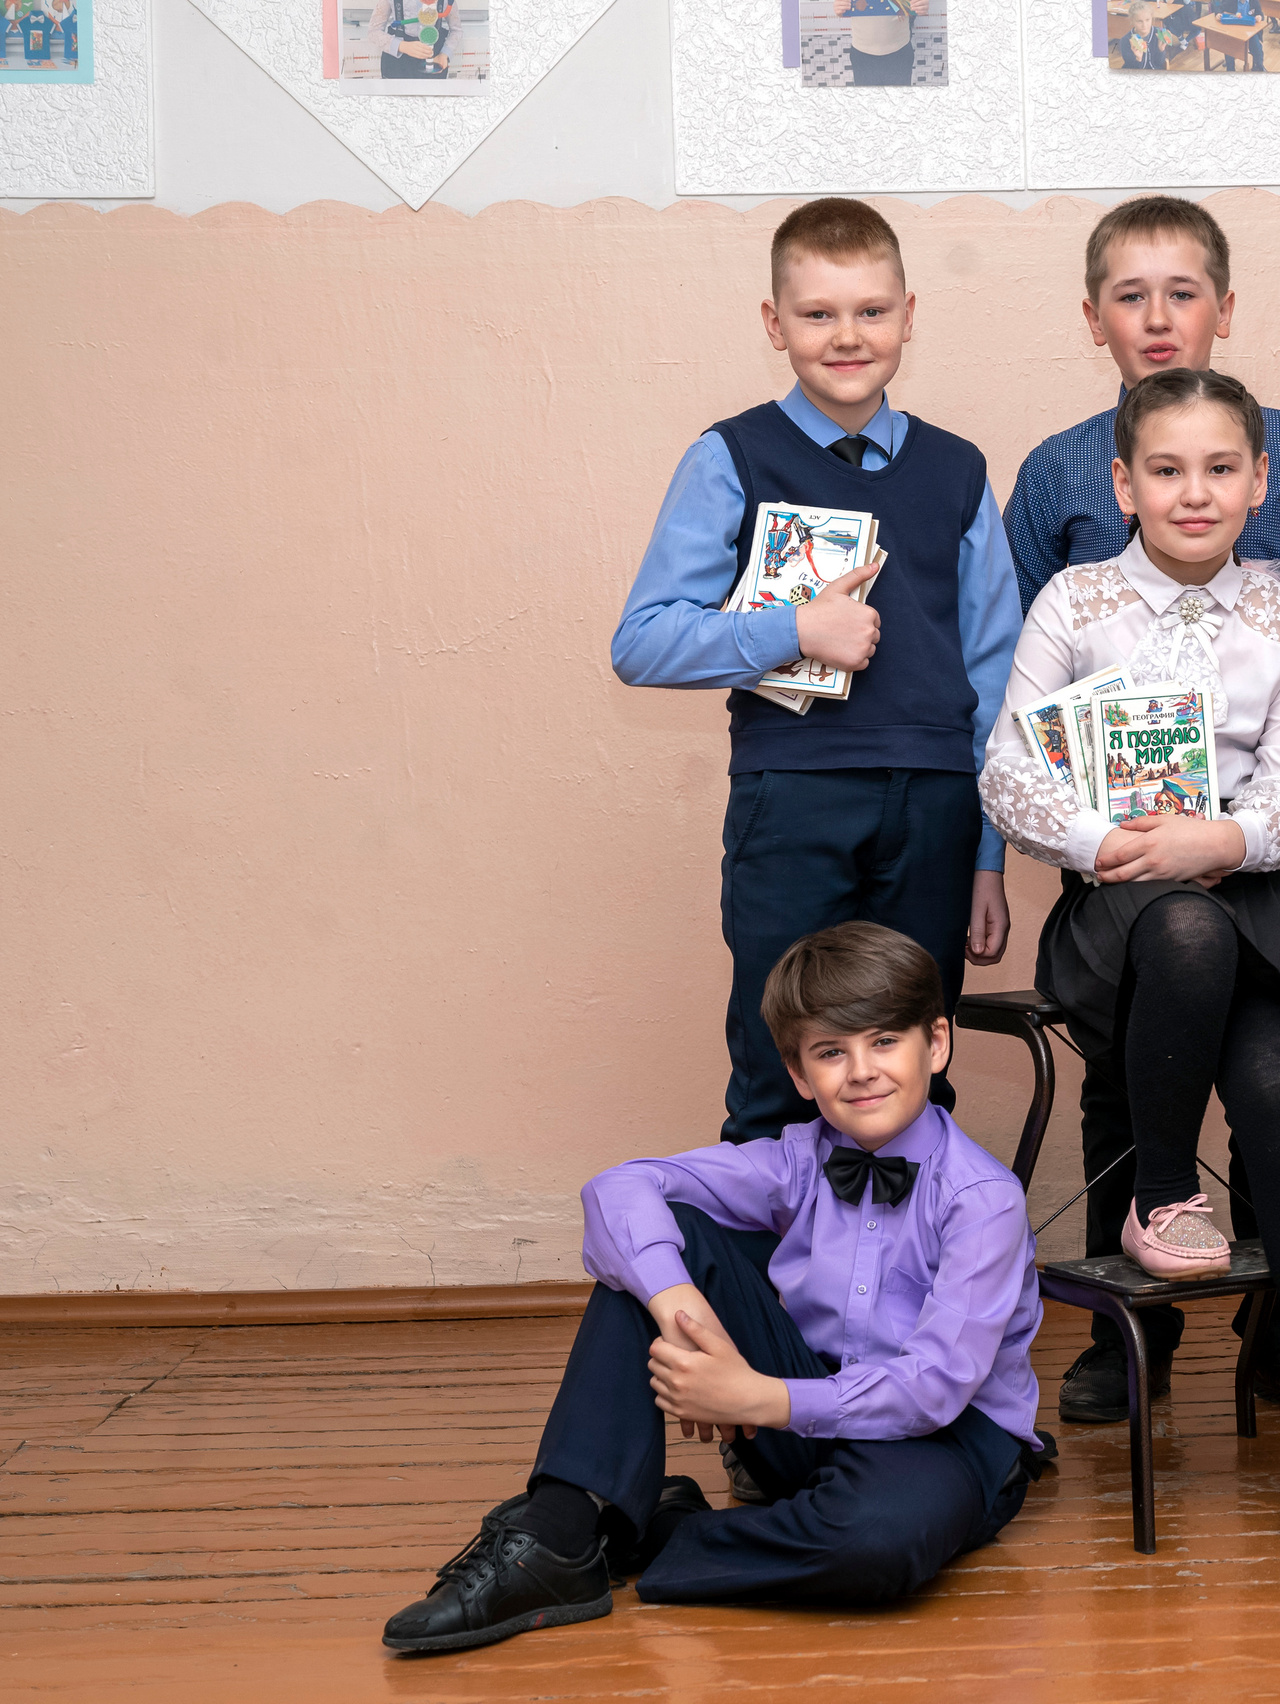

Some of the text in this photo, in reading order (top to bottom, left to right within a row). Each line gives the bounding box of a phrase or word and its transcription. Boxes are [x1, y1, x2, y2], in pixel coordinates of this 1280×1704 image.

[1132, 712, 1175, 722] ГЕОГРАФИЯ
[1109, 726, 1201, 750] Я ПОЗНАЮ
[1134, 746, 1174, 764] МИР
